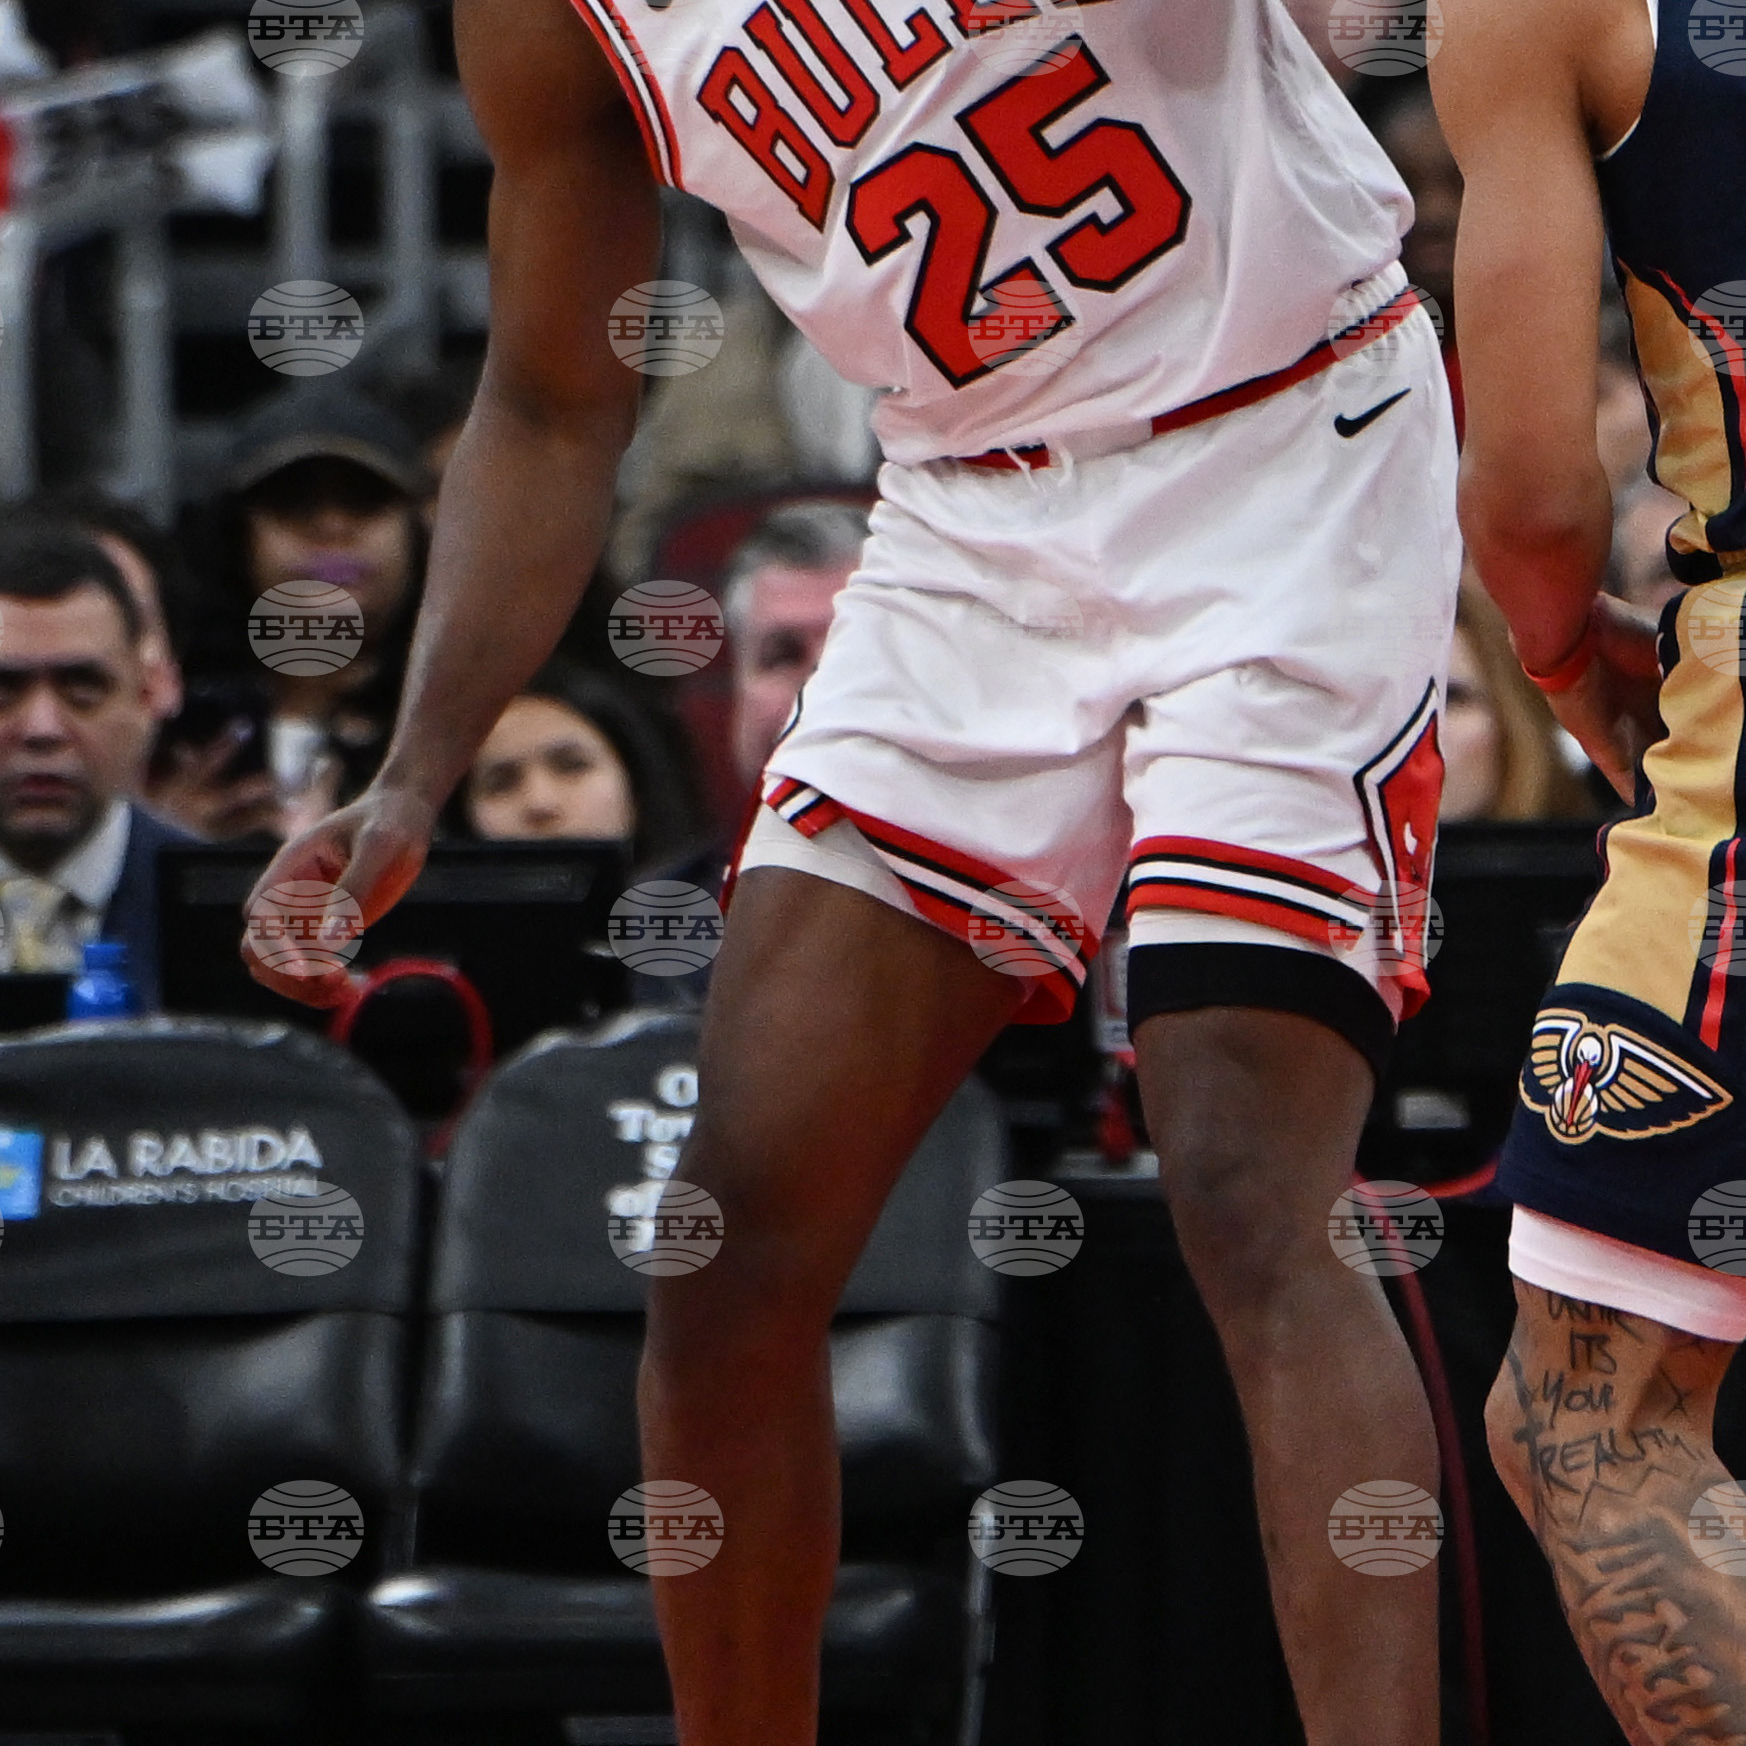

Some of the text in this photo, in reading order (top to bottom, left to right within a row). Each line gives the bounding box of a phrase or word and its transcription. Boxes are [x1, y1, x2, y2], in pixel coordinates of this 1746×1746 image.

[845, 34, 1192, 389] 25
[53, 1118, 324, 1181] LA RABIDA
